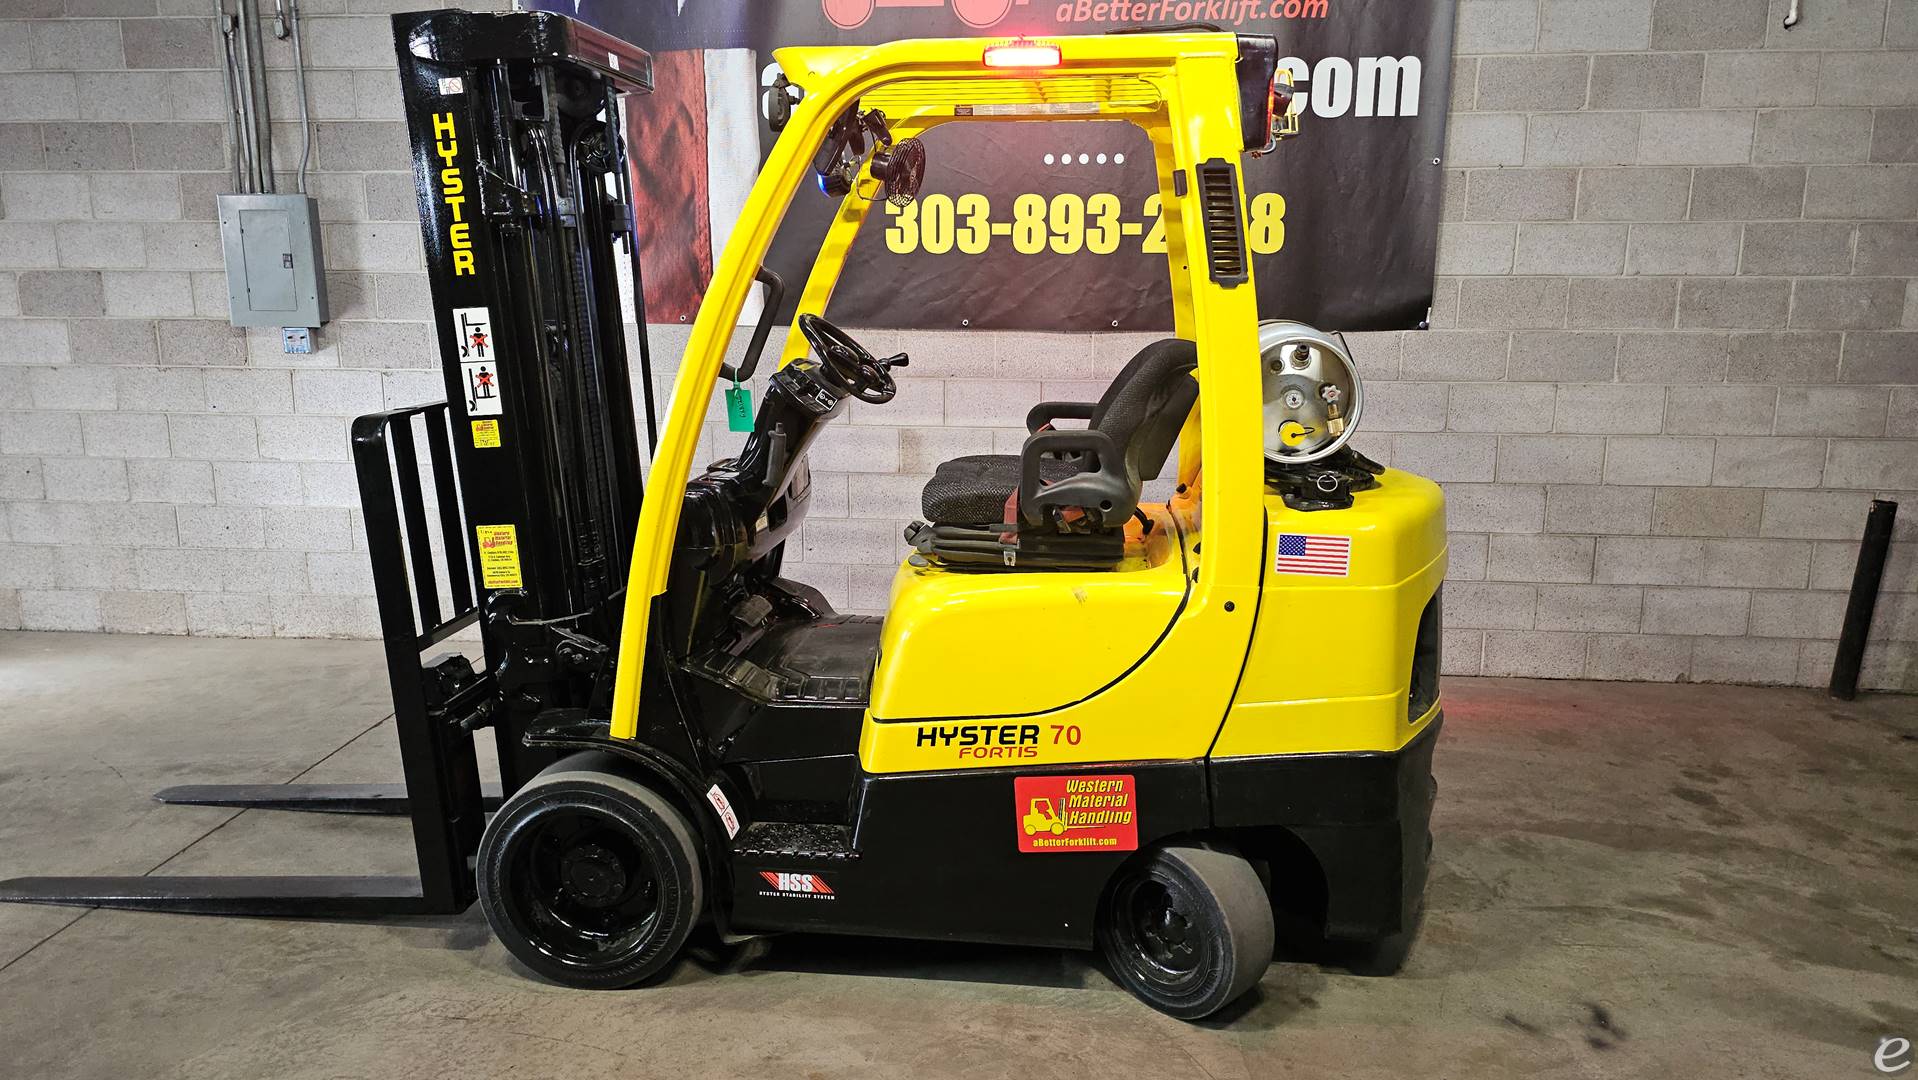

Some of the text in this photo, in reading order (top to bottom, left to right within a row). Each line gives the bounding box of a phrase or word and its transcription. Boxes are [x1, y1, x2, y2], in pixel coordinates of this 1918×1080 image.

[1055, 0, 1329, 25] aBetterForklift.com
[432, 112, 475, 276] HYSTER
[885, 193, 1286, 254] 303-893-28
[916, 725, 1081, 747] HYSTER 70
[959, 746, 1038, 758] FORTIS
[1066, 779, 1123, 793] Western
[1068, 793, 1128, 808] Material
[1069, 810, 1132, 825] Handling
[1033, 837, 1117, 847] aBetterForklift.com
[778, 873, 813, 892] HSS
